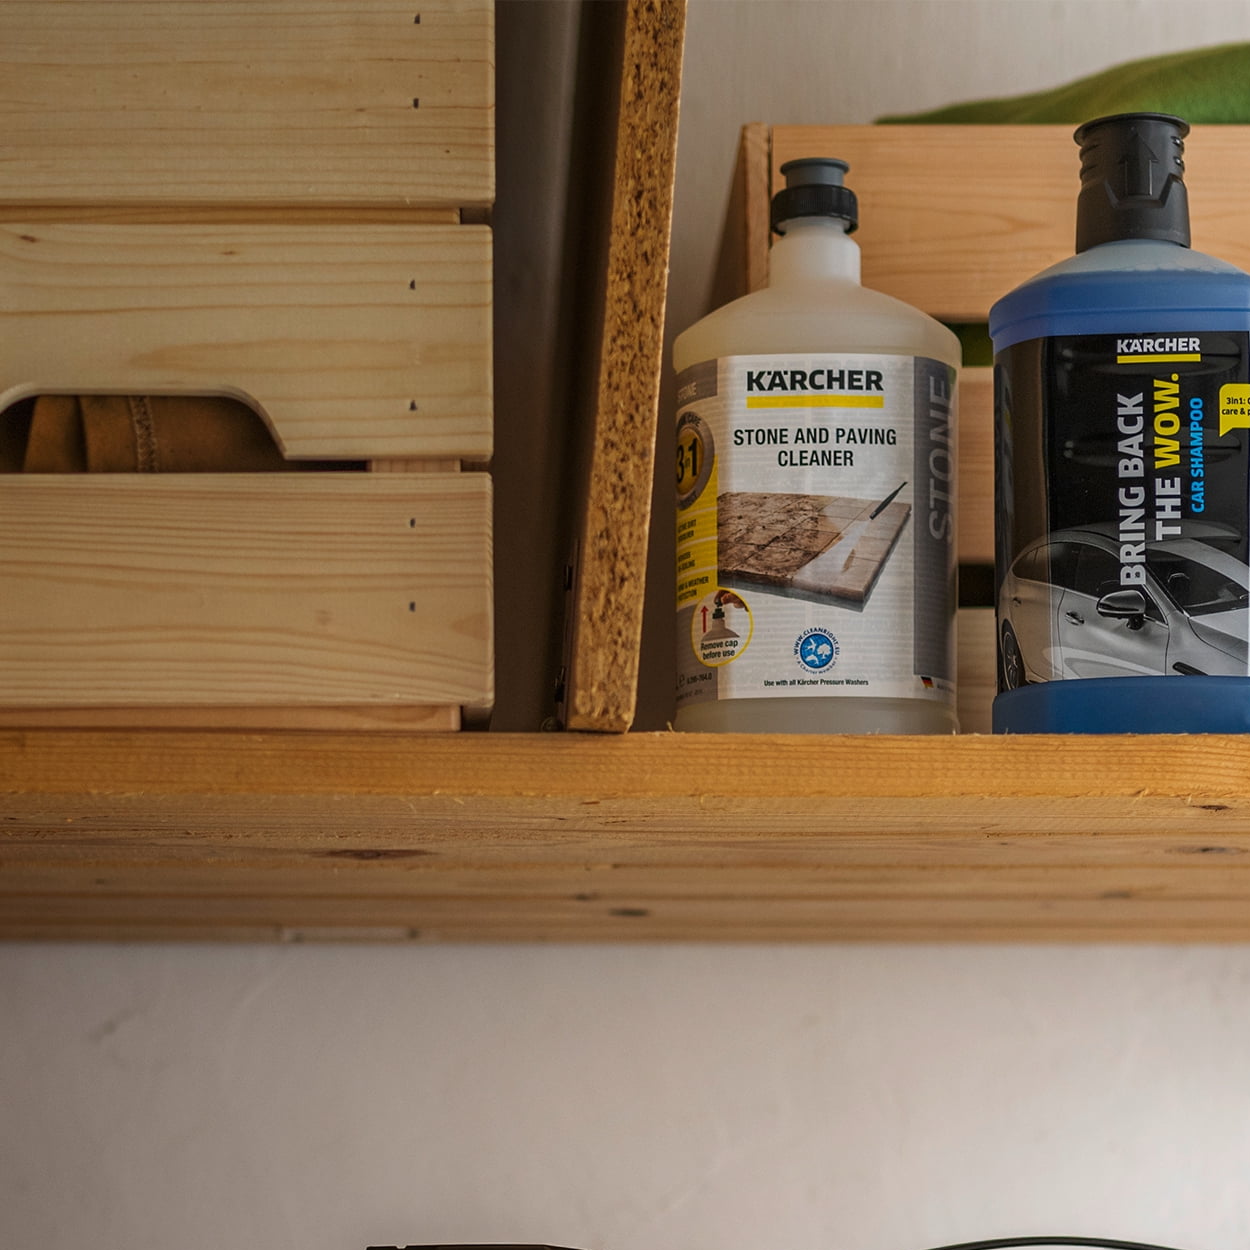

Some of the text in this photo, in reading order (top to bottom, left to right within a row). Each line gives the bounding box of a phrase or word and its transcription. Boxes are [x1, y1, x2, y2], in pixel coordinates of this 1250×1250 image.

[1117, 337, 1201, 352] KÄRCHER
[746, 369, 884, 392] KÄRCHER
[733, 427, 897, 446] STONE AND PAVING
[777, 450, 854, 467] CLEANER
[929, 376, 955, 544] STONE
[1153, 373, 1182, 541] THE WOW.
[1189, 397, 1205, 513] CAR SHAMPOO
[1117, 392, 1147, 586] BRING BACK
[700, 639, 738, 651] Remove cap
[703, 649, 735, 660] before use
[820, 678, 844, 686] Pressure
[845, 678, 869, 686] Washers
